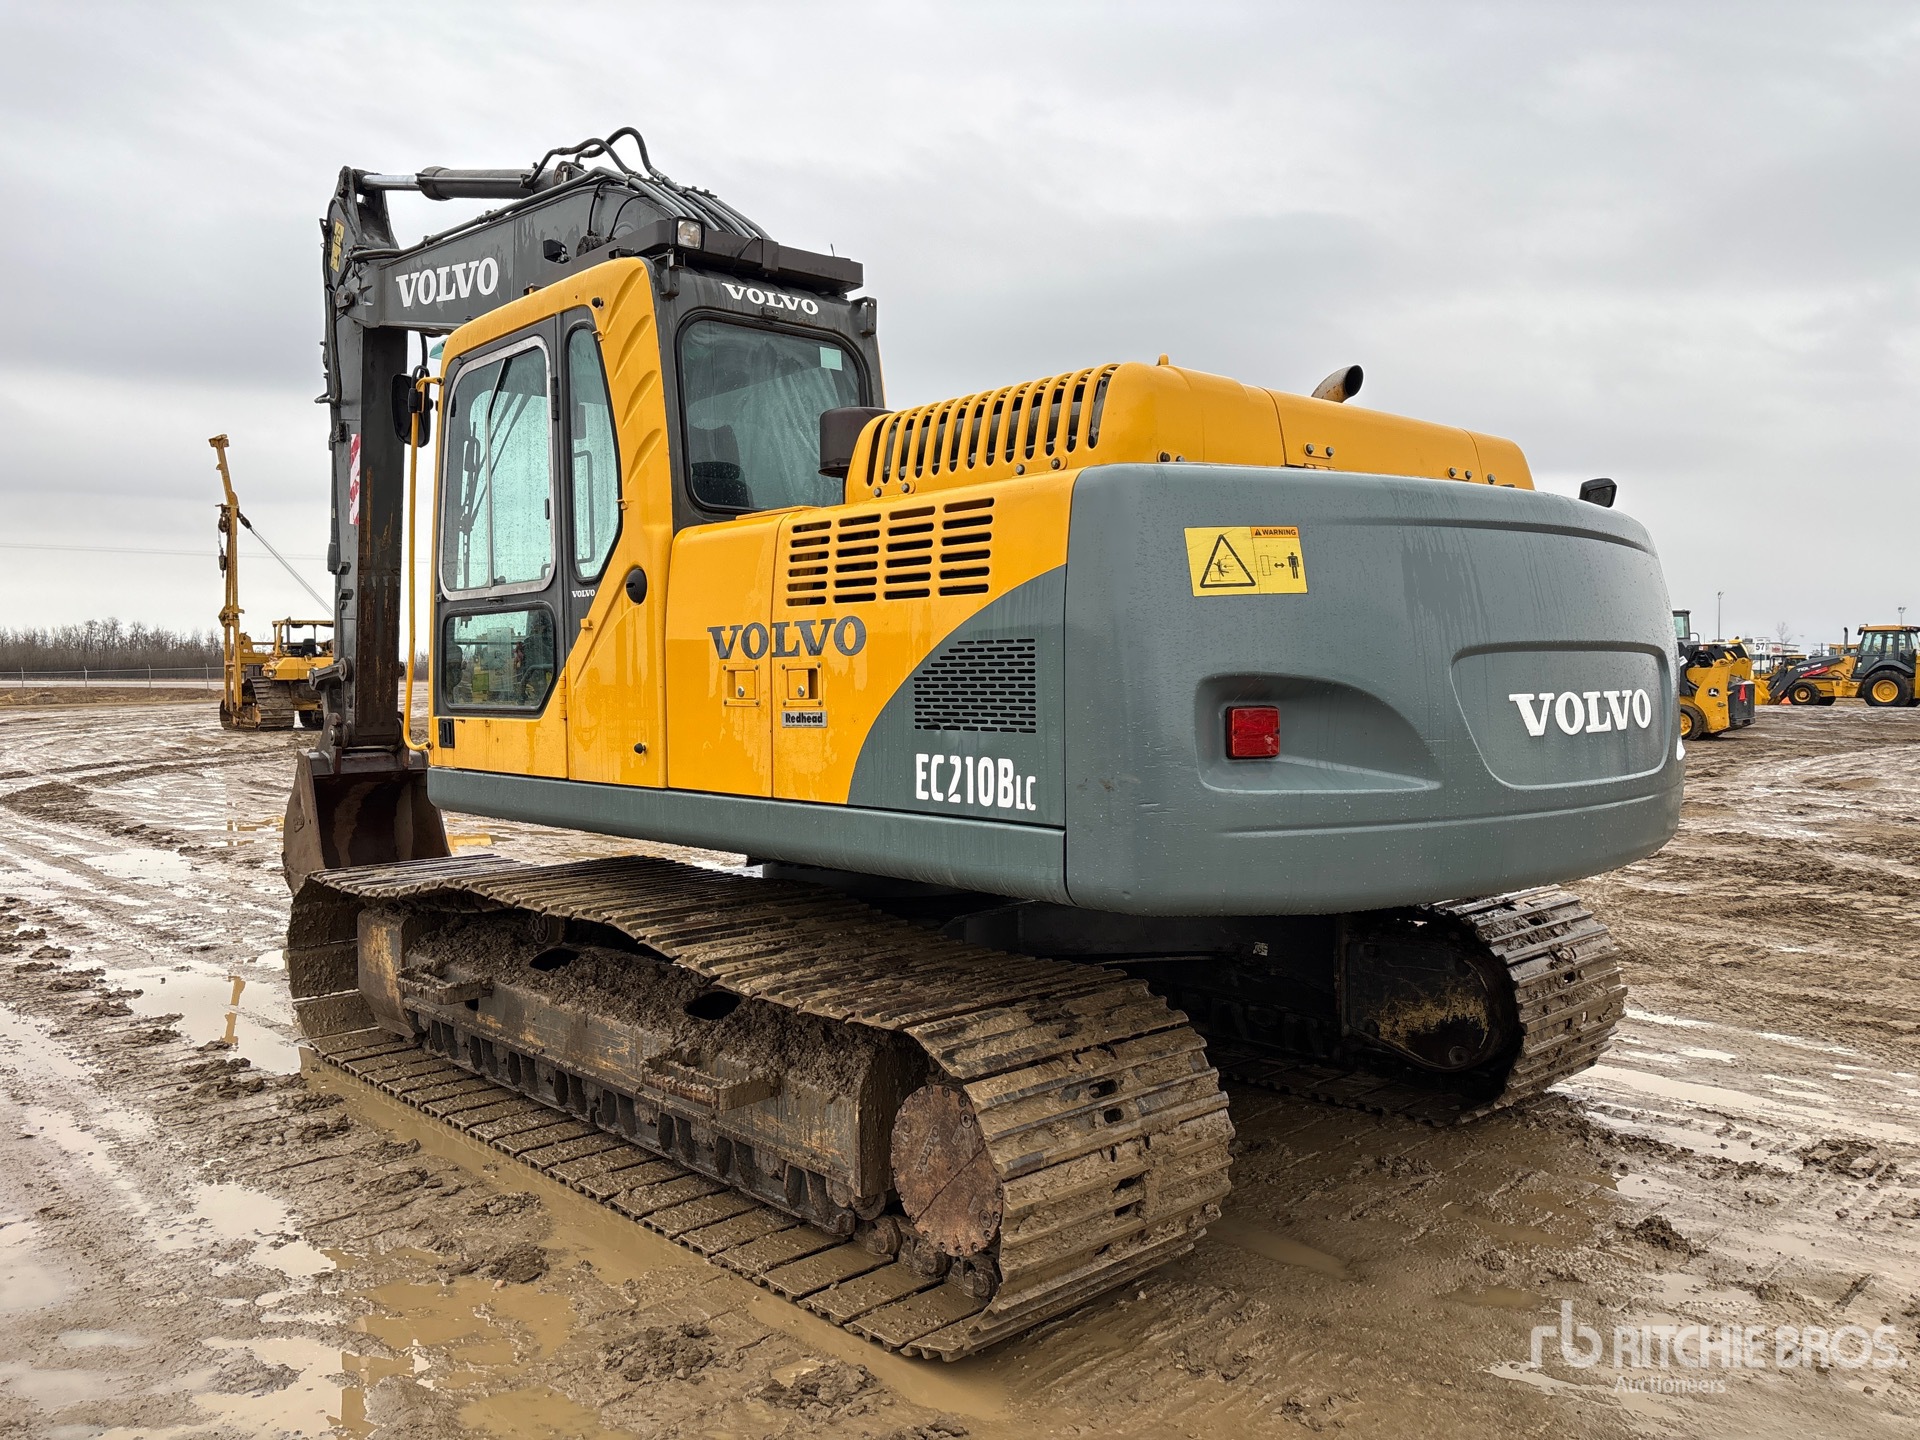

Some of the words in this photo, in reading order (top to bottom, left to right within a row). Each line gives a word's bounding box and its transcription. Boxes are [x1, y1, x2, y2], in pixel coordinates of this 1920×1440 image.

[395, 257, 499, 307] VOLVO
[721, 282, 819, 315] VOLVO
[571, 589, 596, 598] VOLVO
[707, 615, 867, 660] VOLVO
[1755, 642, 1765, 651] 57
[785, 712, 823, 723] Redhead
[1508, 688, 1652, 737] VOLVO
